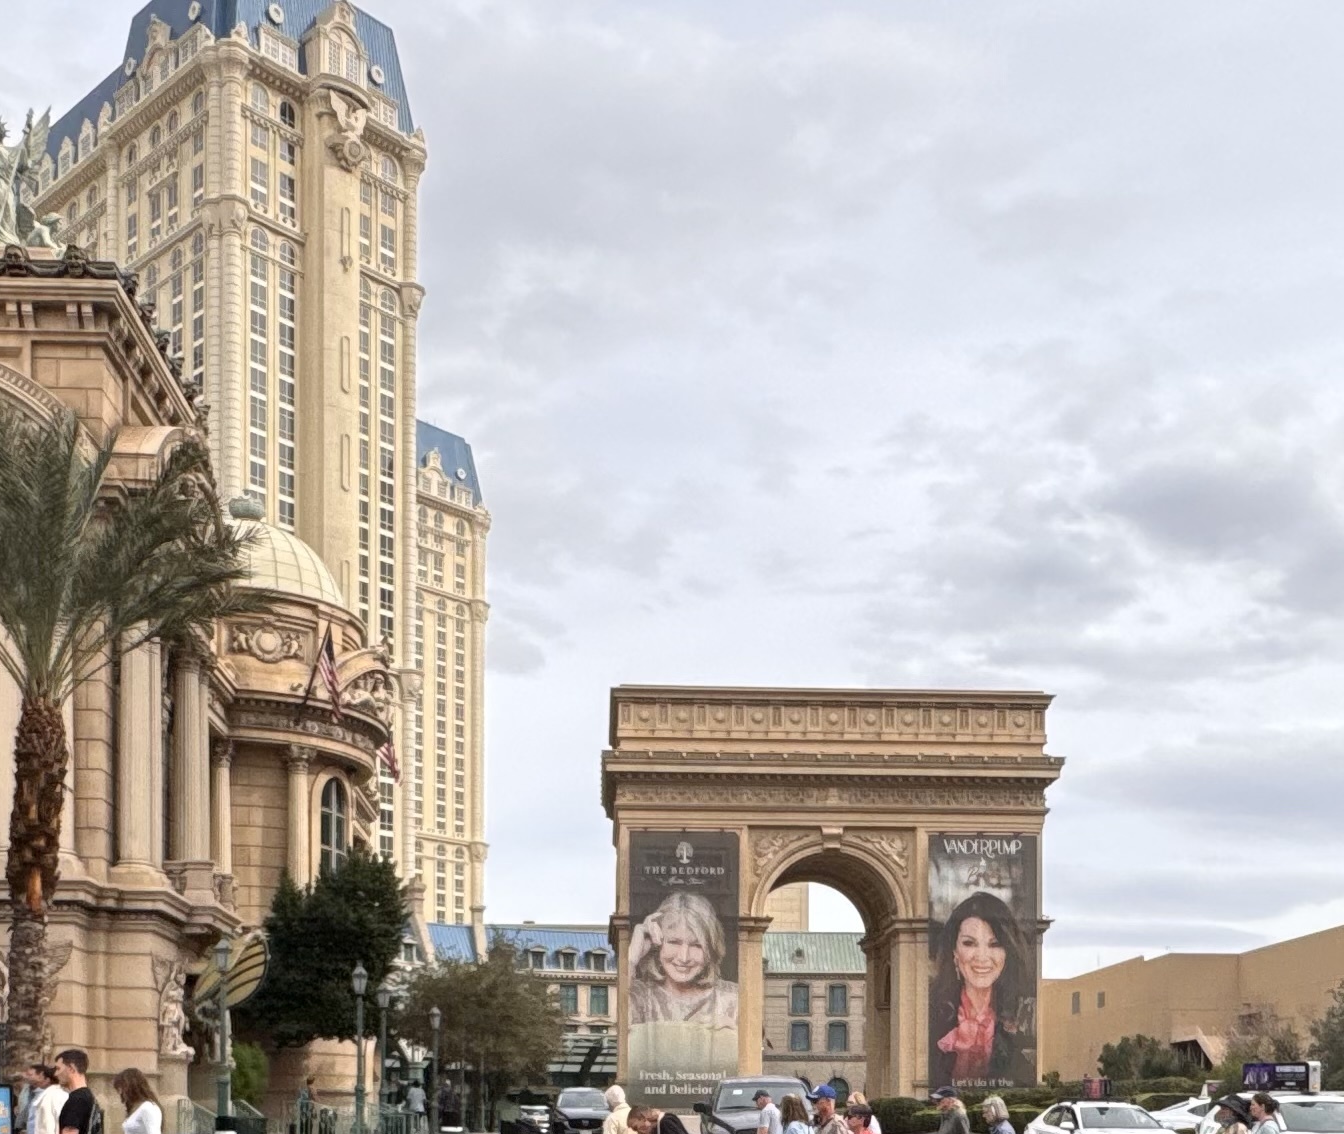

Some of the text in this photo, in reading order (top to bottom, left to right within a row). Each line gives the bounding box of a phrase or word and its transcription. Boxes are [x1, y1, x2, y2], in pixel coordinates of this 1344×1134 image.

[943, 838, 1022, 859] VANDERPUMP
[644, 866, 725, 875] THE BEDFORD
[639, 1069, 727, 1082] Fresh, Seasonal
[998, 1077, 1014, 1087] the
[644, 1084, 714, 1095] and Delicio
